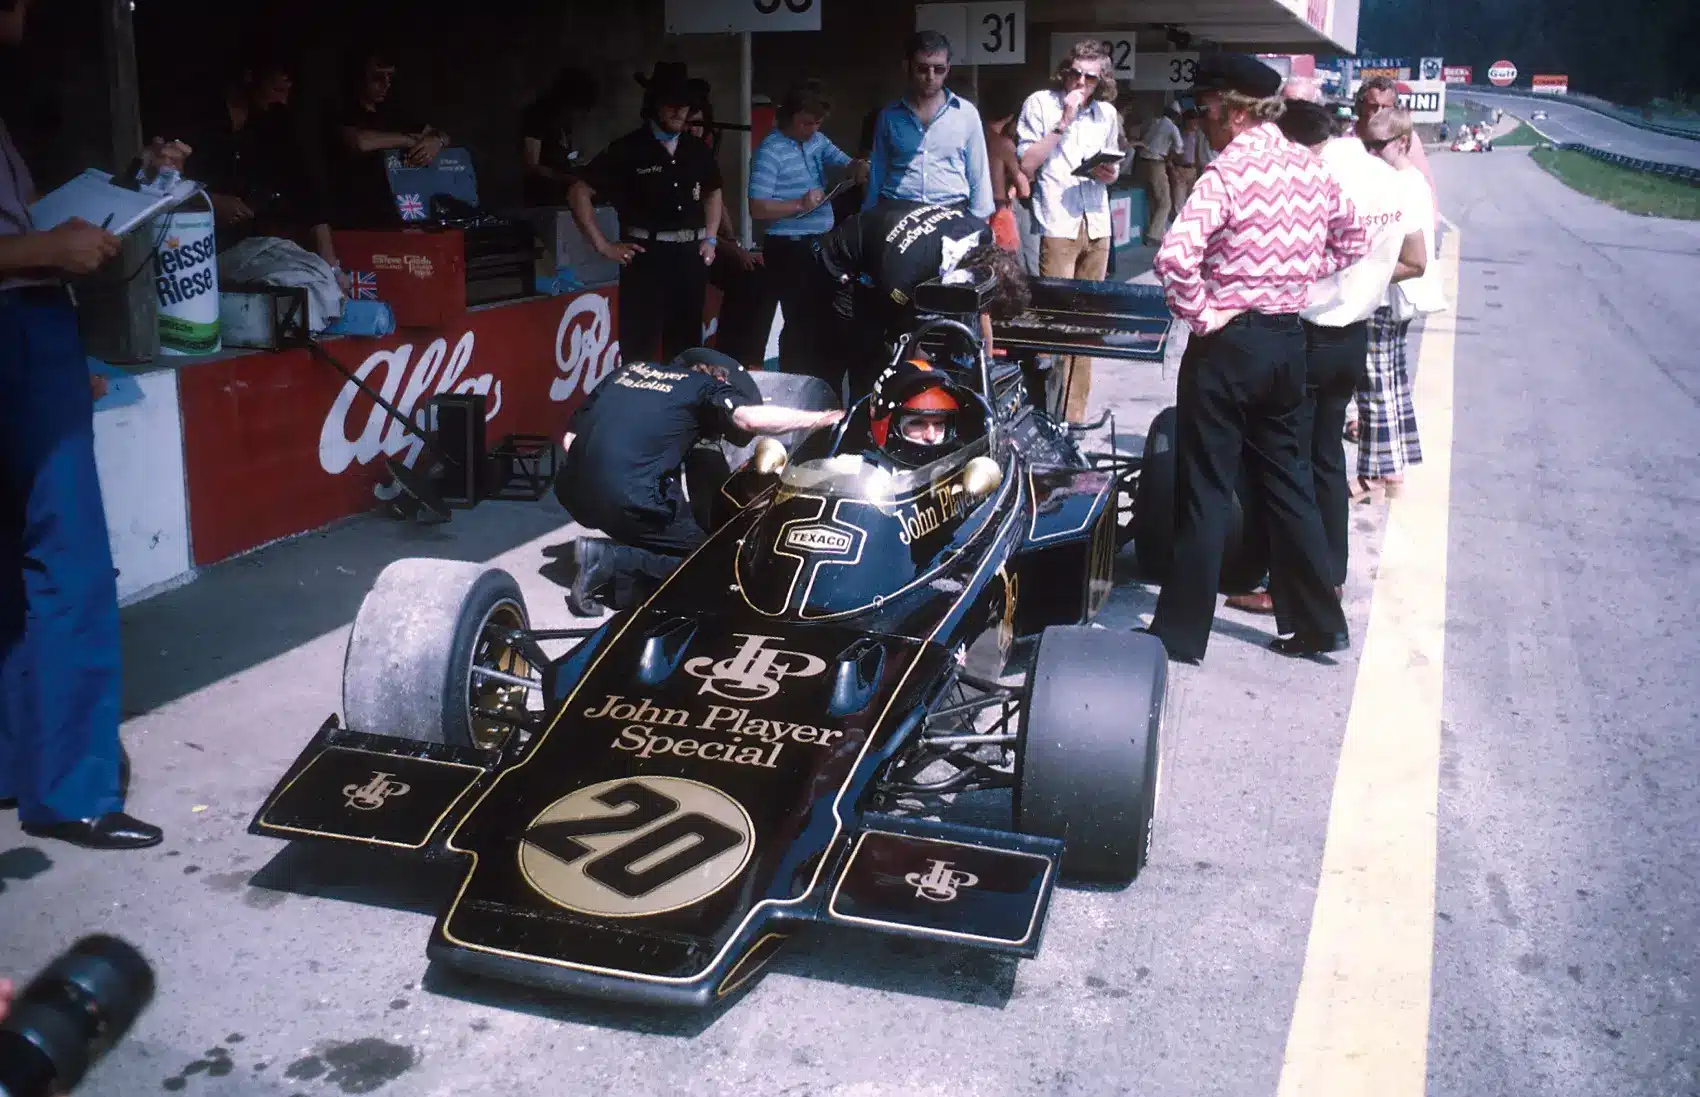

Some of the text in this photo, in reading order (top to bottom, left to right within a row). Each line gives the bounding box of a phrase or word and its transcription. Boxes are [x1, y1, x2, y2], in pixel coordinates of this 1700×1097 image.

[982, 13, 1015, 52] 31
[1169, 58, 1196, 83] 33
[1398, 93, 1438, 110] TINI
[156, 267, 213, 307] Riese
[791, 532, 847, 548] TEXACO
[892, 501, 941, 545] John
[583, 694, 843, 747] John Player
[611, 724, 785, 768] Special
[521, 782, 746, 899] 20
